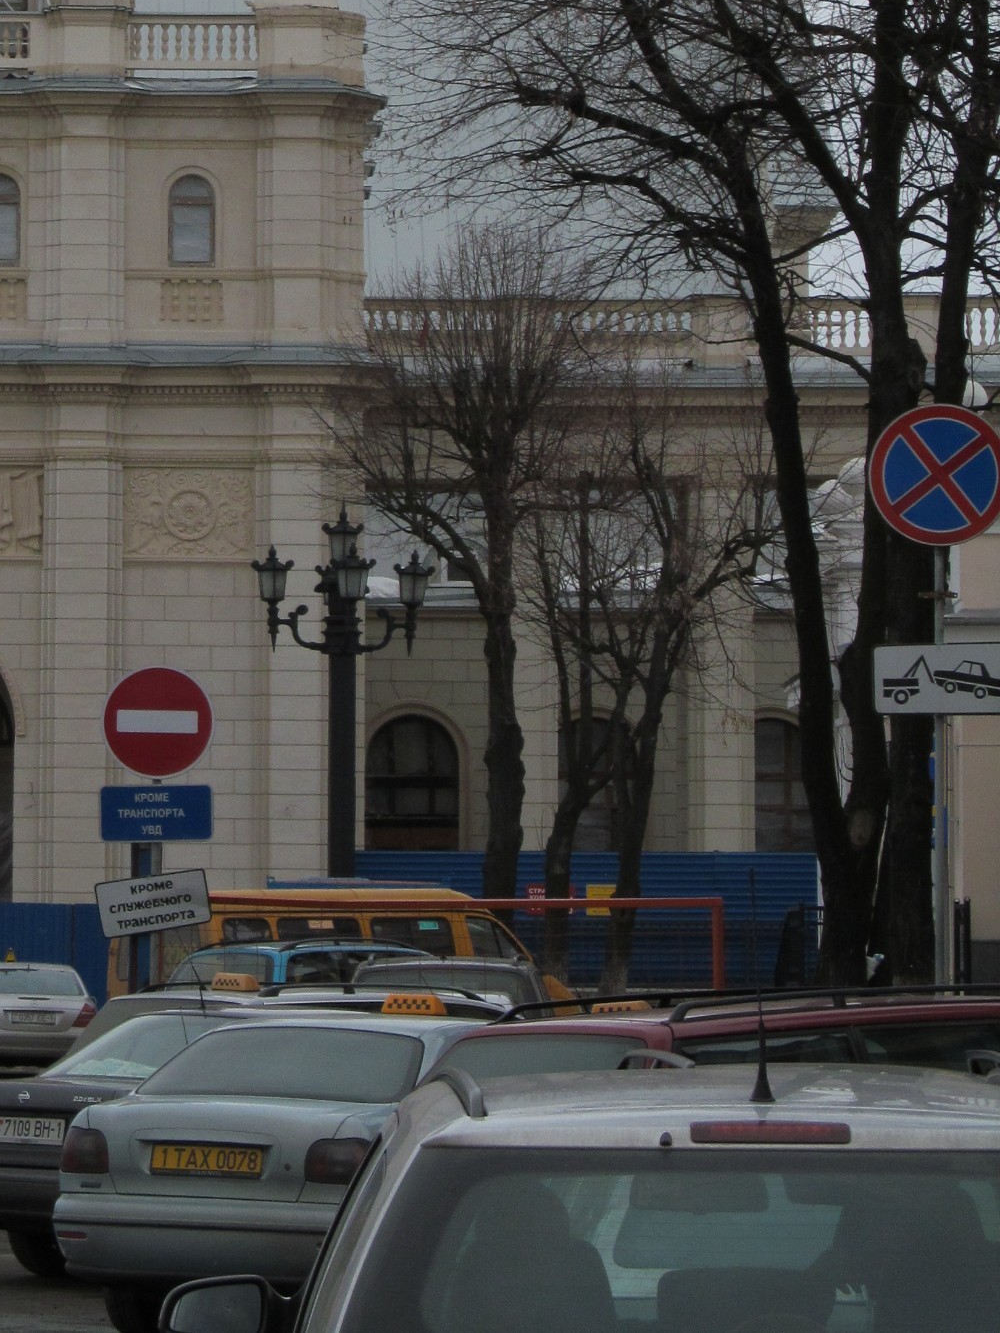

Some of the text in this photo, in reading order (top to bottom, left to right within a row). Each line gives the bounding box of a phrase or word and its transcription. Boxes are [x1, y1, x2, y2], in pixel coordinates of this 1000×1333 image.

[134, 793, 169, 803] КРОМЕ
[117, 808, 185, 819] ТРАНСПОРТА
[141, 825, 163, 835] УВД
[3, 1119, 62, 1138] 7109 BH-1
[162, 1148, 258, 1171] 1 TAX 0078
